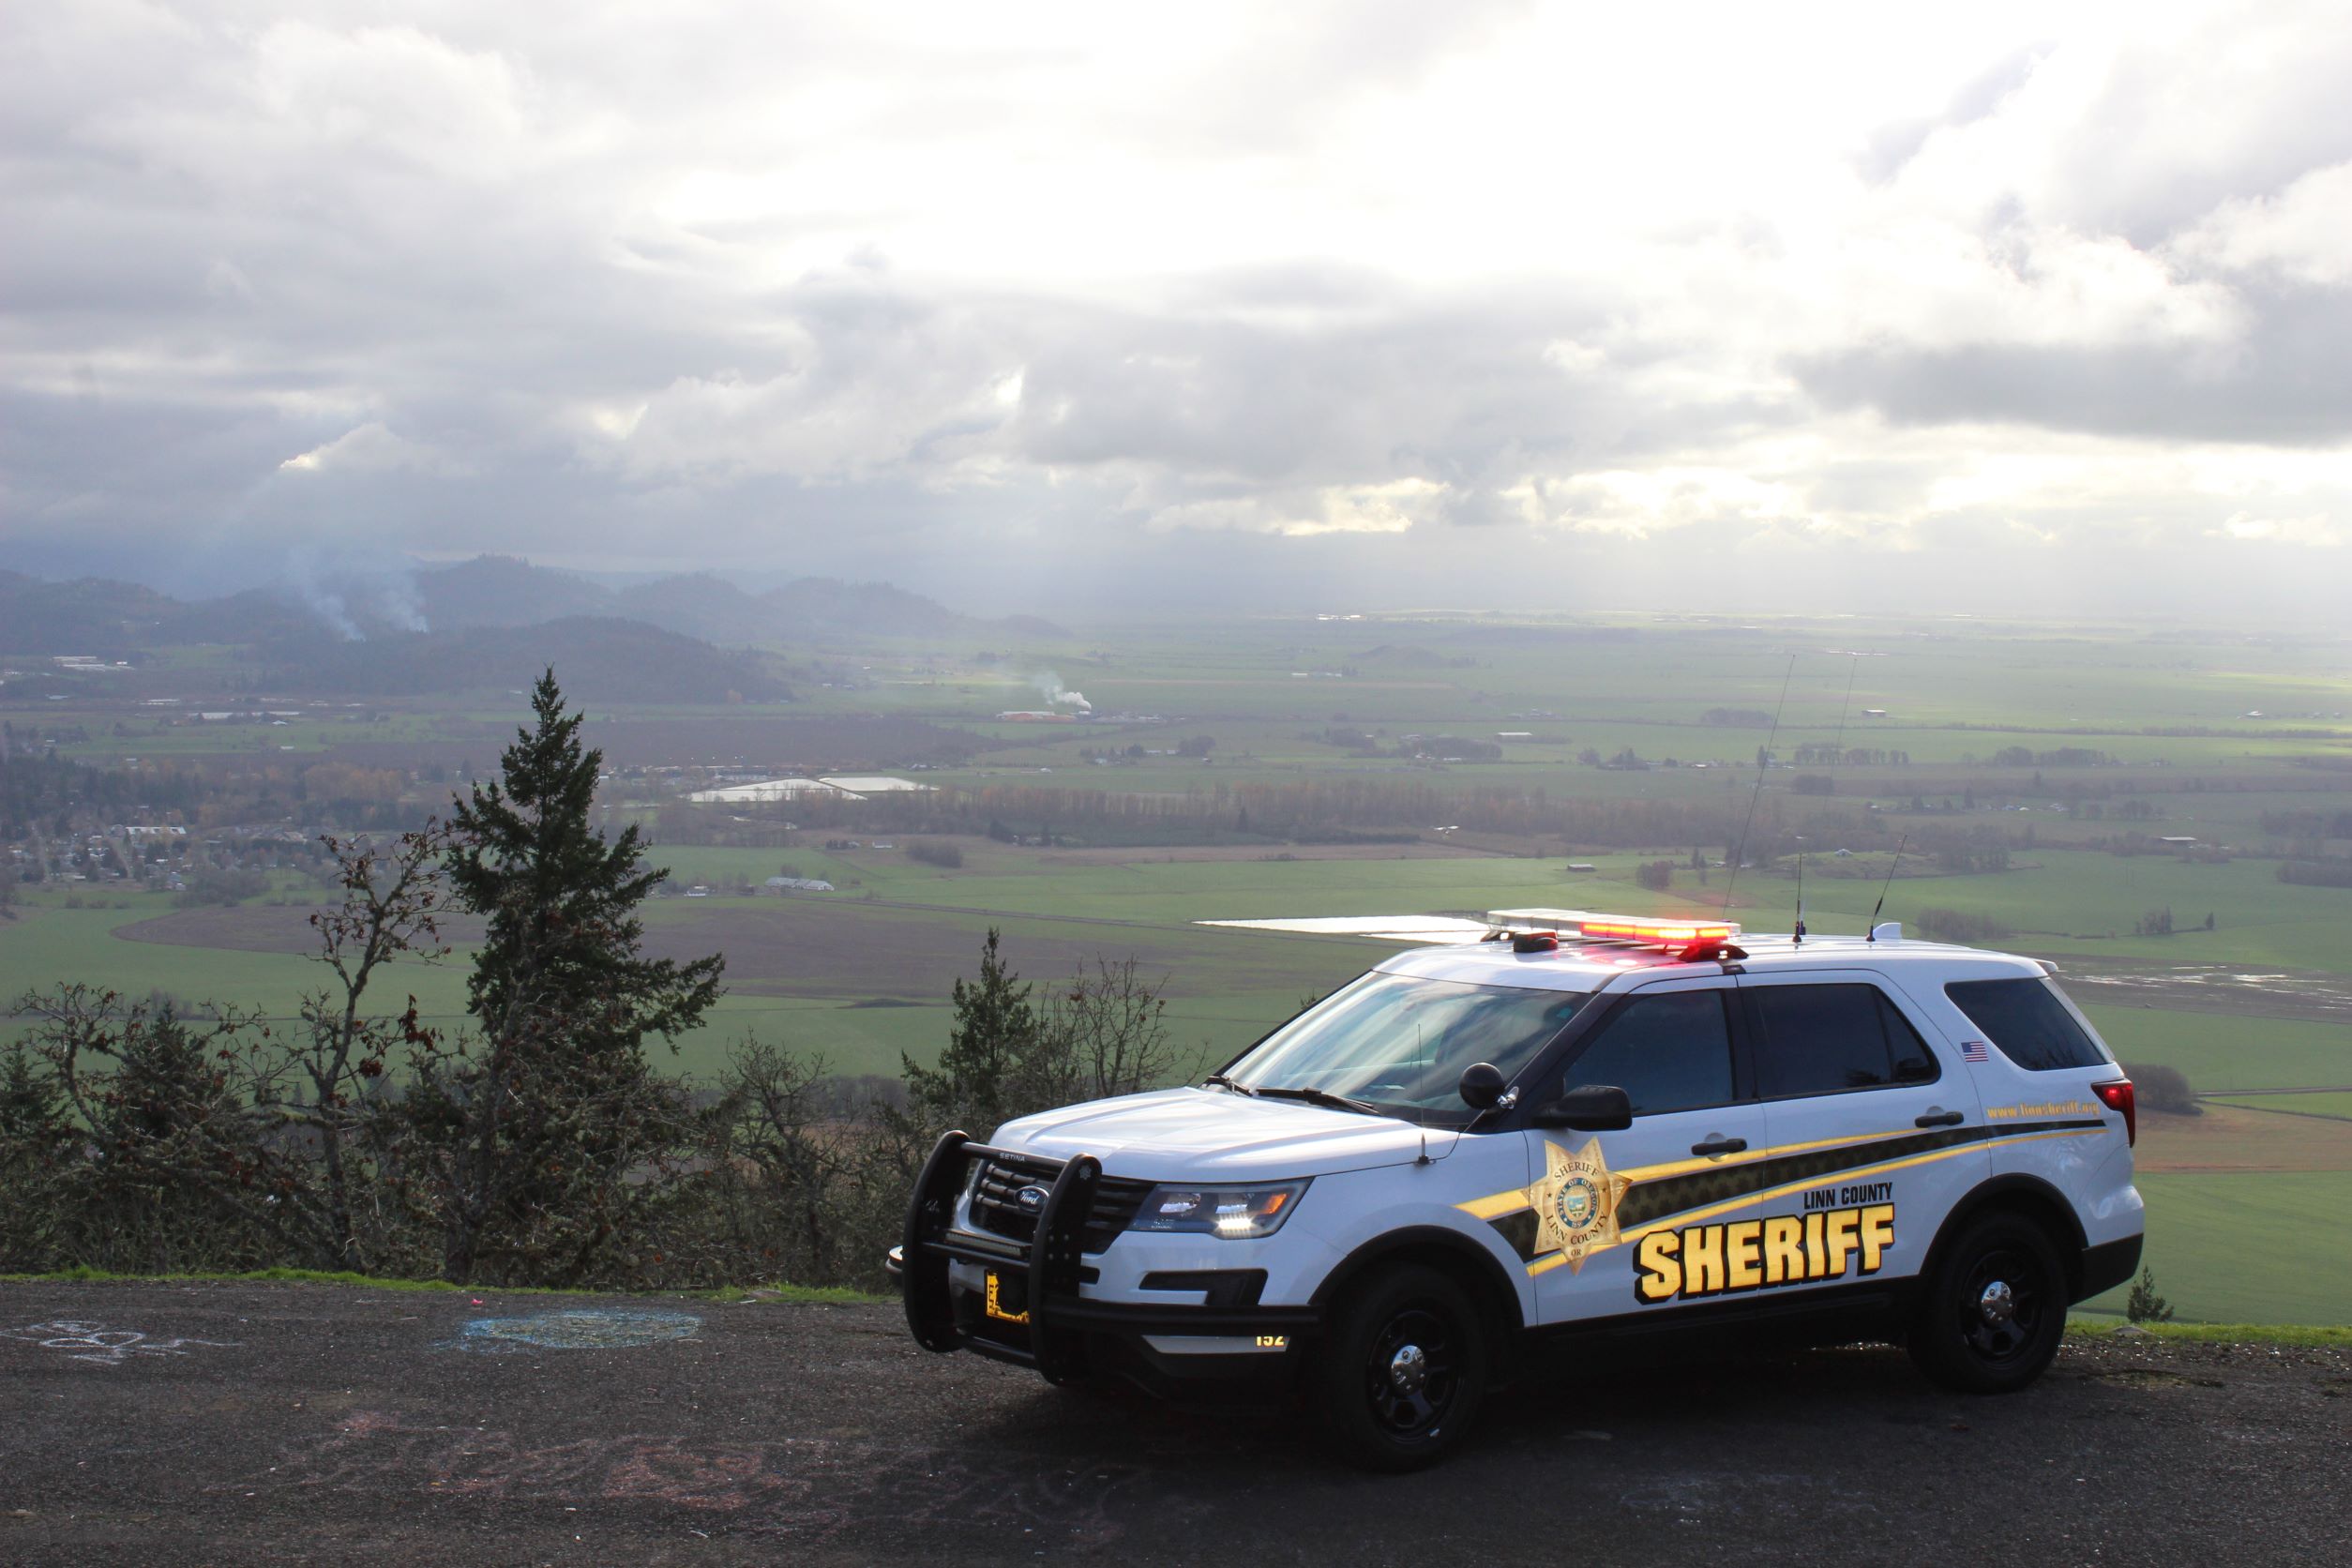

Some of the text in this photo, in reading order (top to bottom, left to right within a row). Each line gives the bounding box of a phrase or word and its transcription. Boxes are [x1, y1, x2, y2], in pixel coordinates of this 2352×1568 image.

[999, 1153, 1025, 1162] SETINA
[1555, 1162, 1599, 1182] SHERIFF
[1019, 1190, 1039, 1205] Ford
[1804, 1183, 1892, 1210] LINN COUNTY
[1546, 1212, 1607, 1245] LINN COUNTY
[1634, 1203, 1894, 1304] SHERIFF
